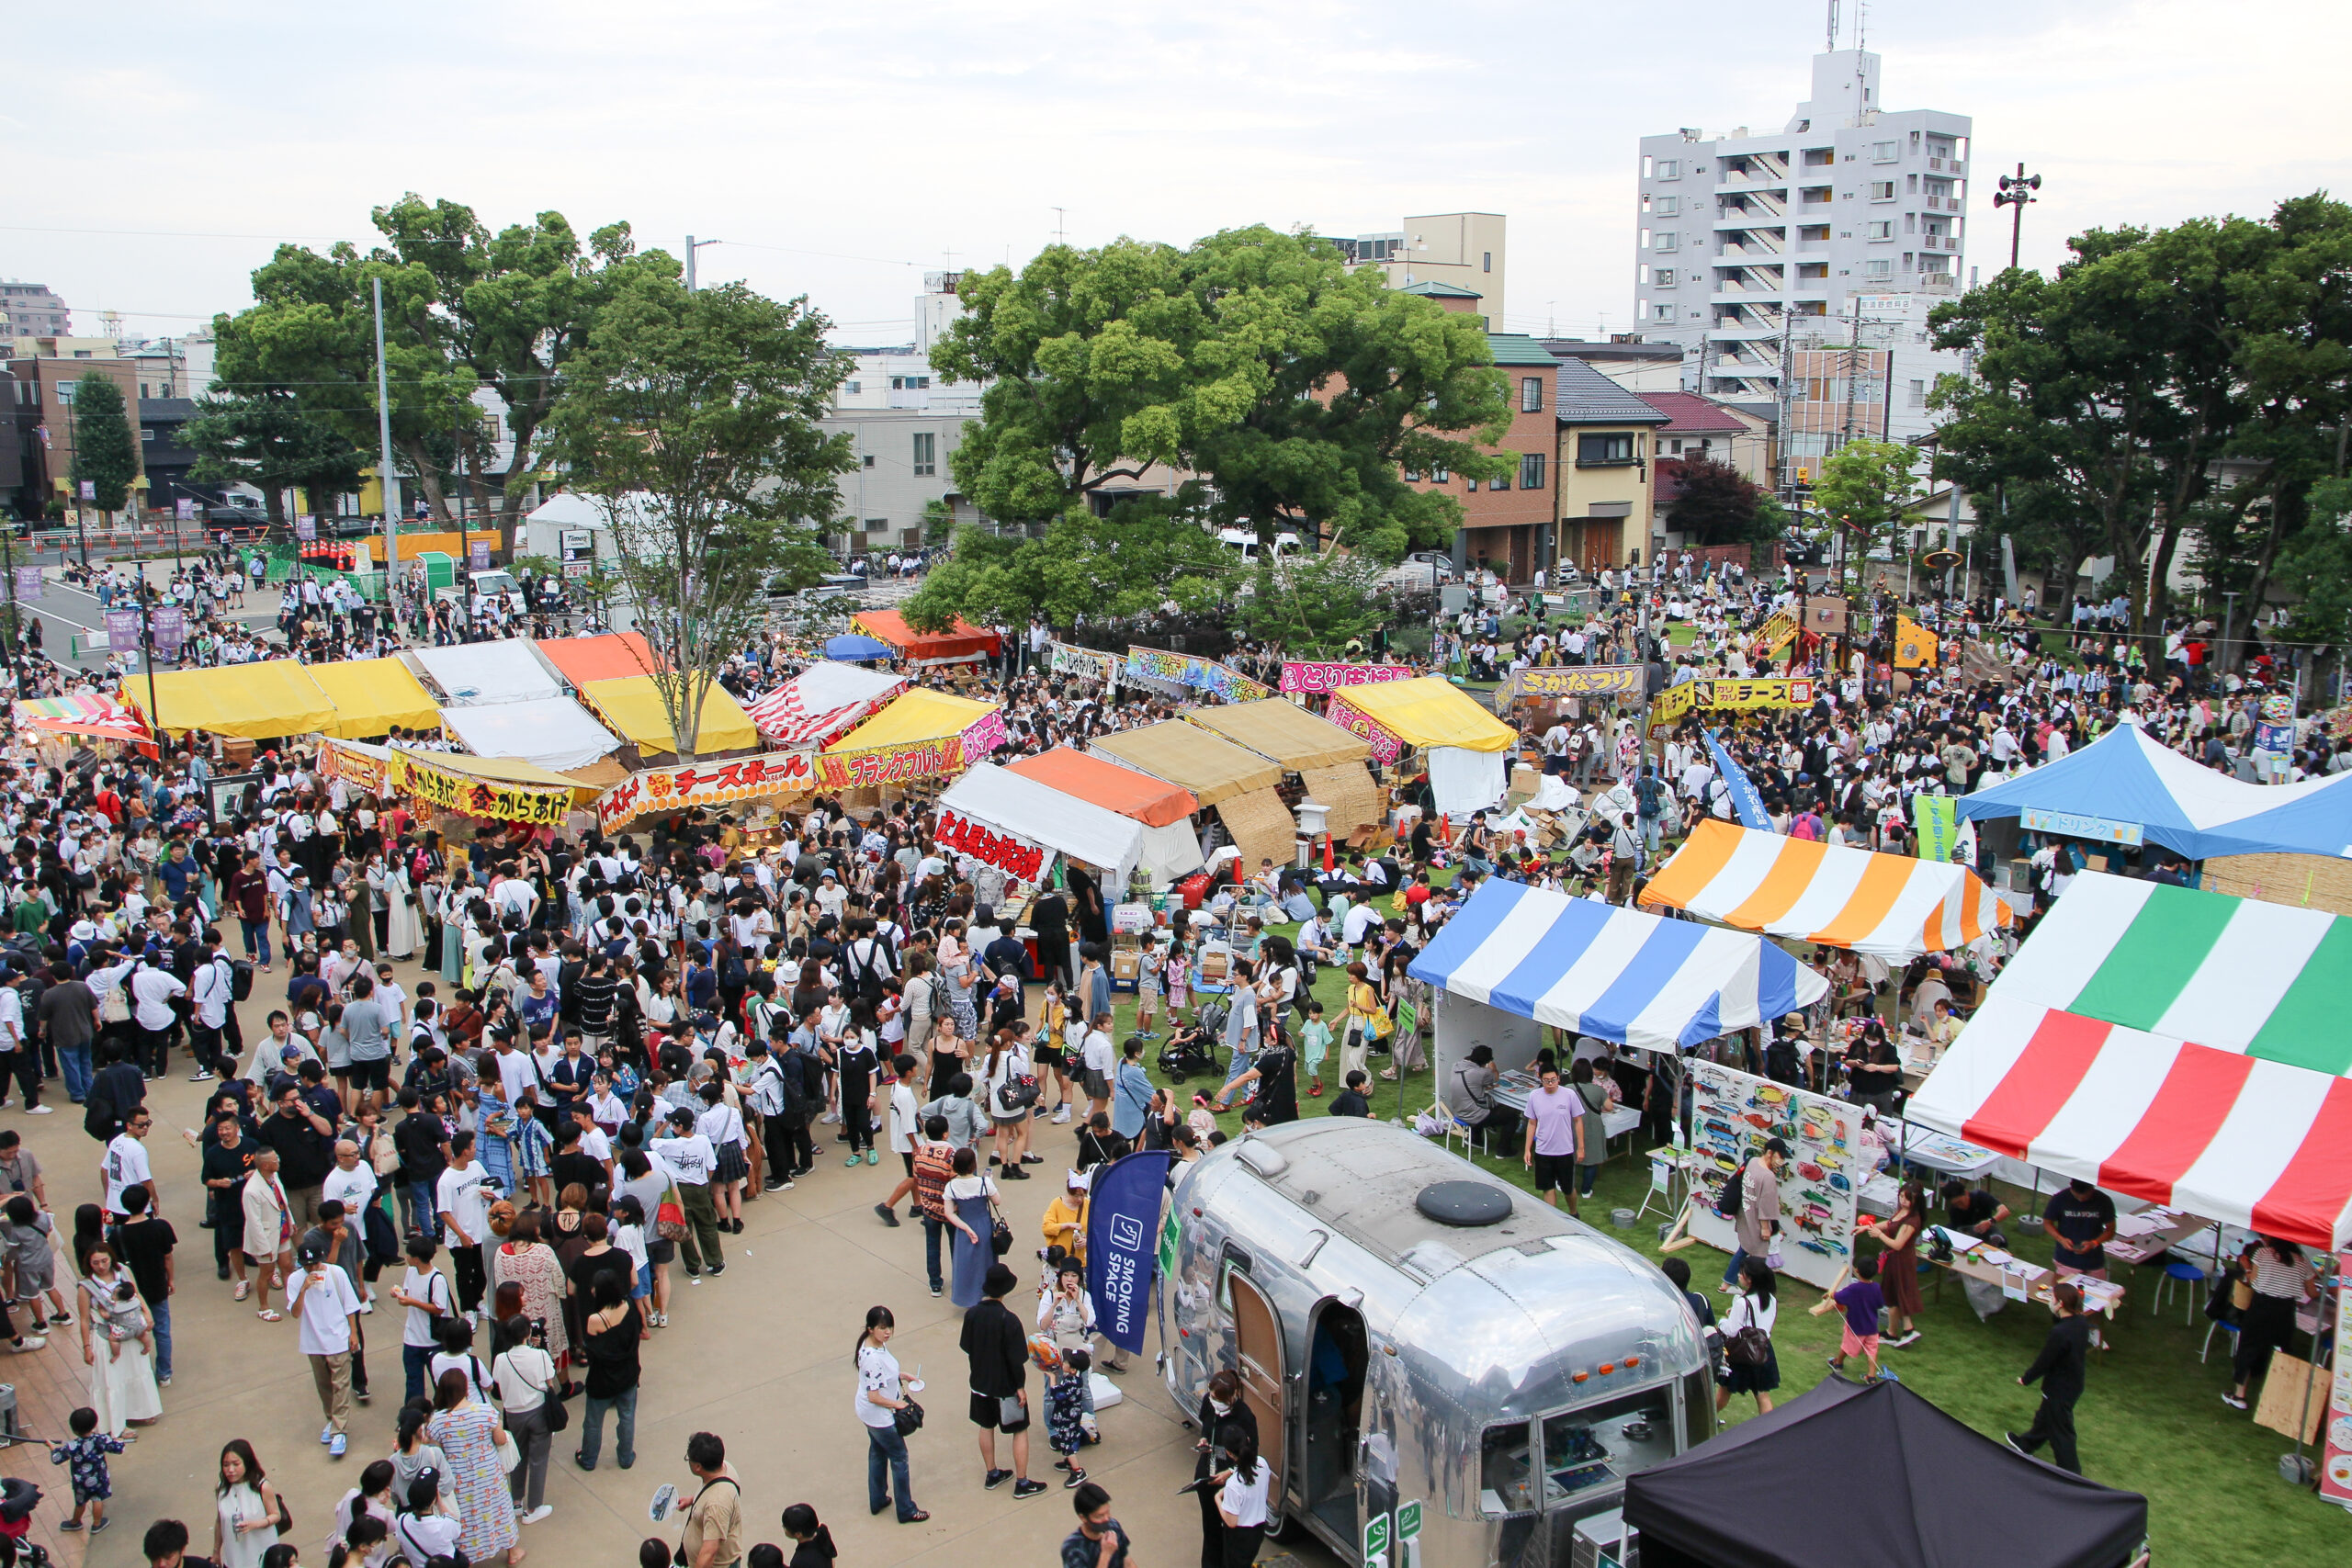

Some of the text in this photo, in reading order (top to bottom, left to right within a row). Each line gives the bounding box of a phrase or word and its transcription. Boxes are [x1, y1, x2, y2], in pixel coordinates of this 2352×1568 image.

[1521, 670, 1634, 693] さかなつり
[1738, 683, 1809, 702] チーズ 揚
[674, 754, 808, 795] チーズボール
[849, 745, 943, 787] フランクフルト
[469, 784, 569, 821] 金のからあげ
[1727, 757, 1770, 830] ひらつか名産品
[933, 809, 1044, 883] 広島風お好み焼
[2057, 816, 2109, 837] ドリンク
[1105, 1252, 1123, 1303] SPACE
[1116, 1257, 1136, 1334] SMOKING
